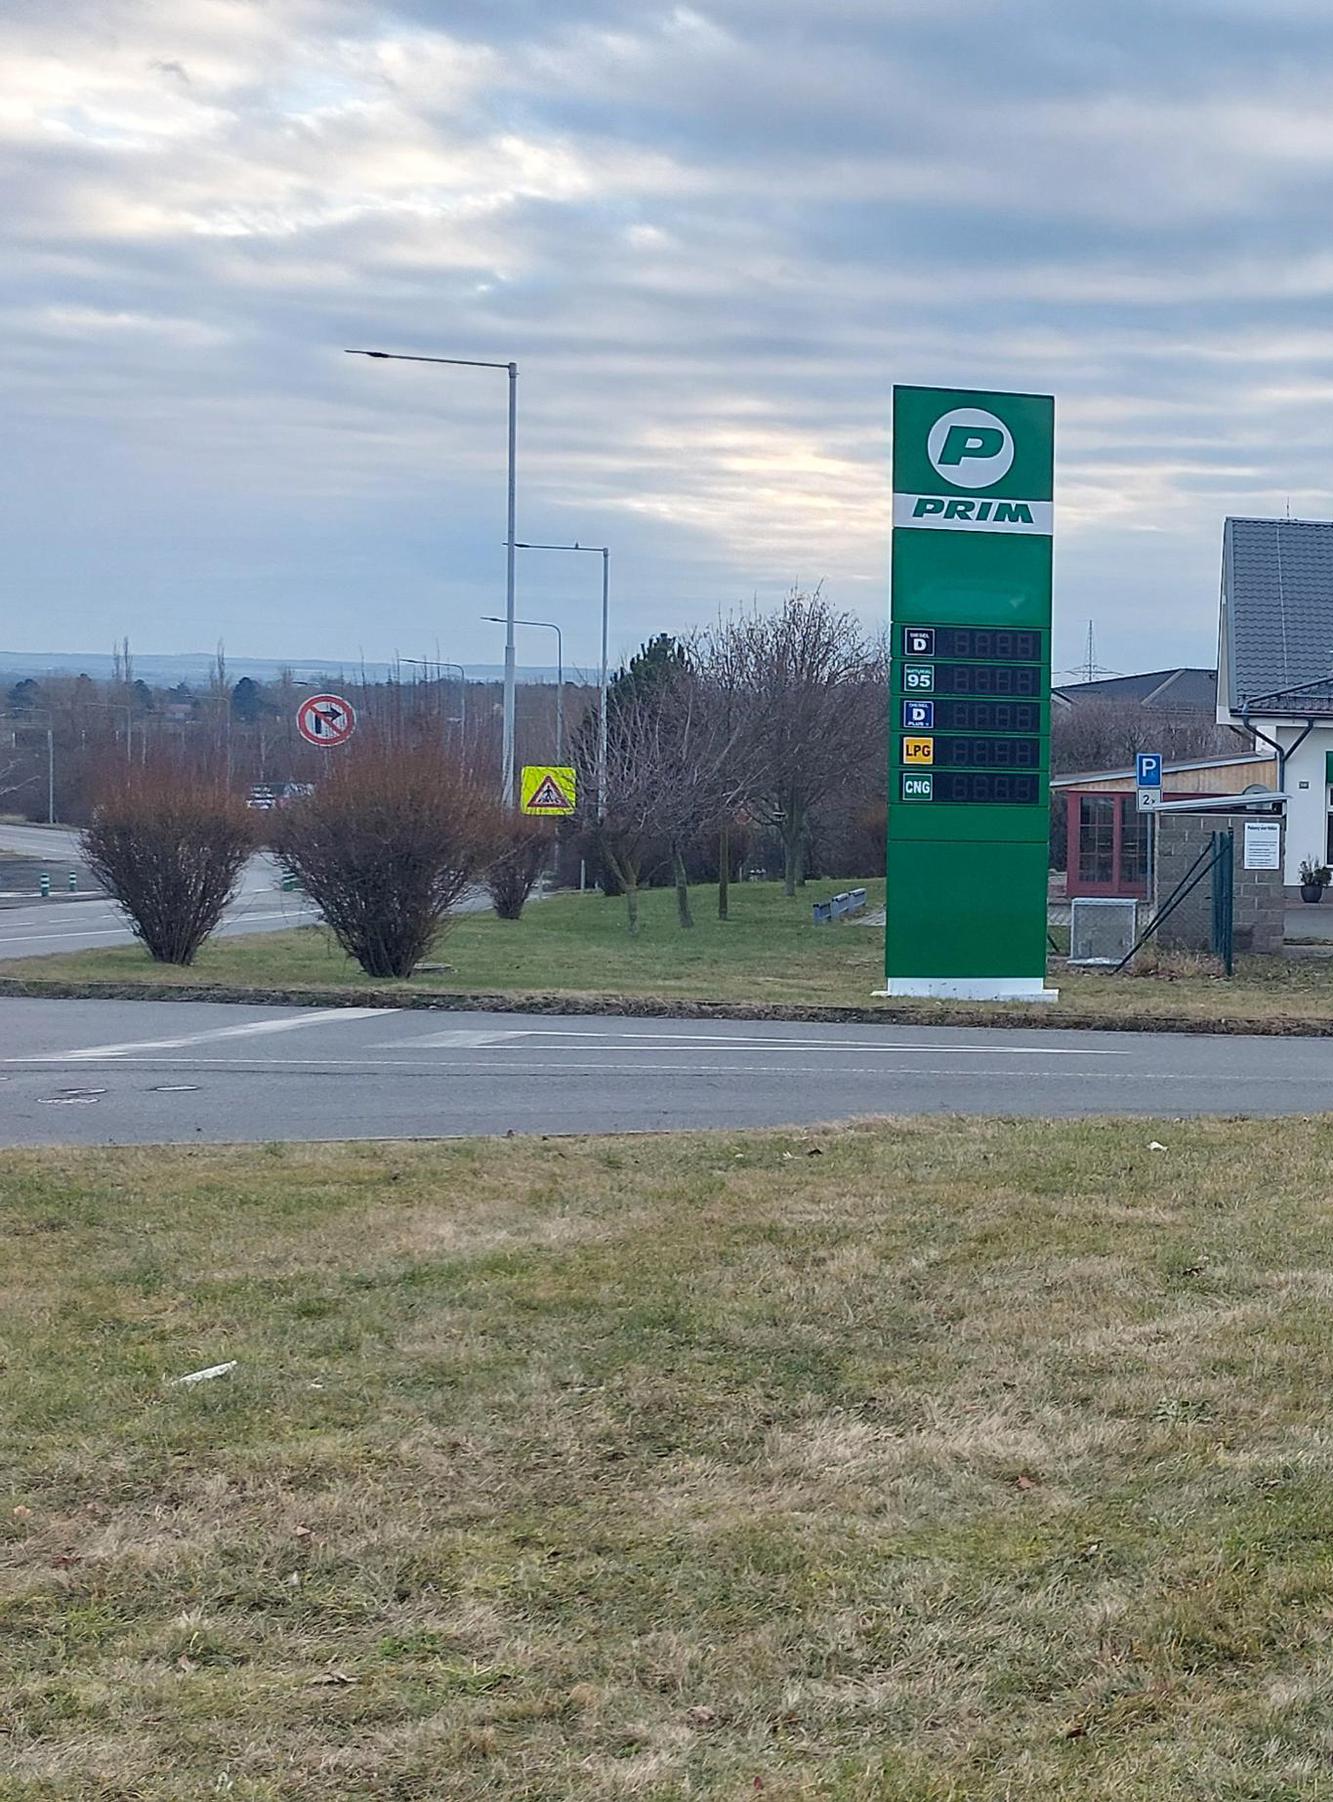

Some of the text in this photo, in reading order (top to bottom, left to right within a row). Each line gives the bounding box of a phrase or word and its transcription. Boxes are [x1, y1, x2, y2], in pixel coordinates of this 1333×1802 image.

[938, 425, 1005, 466] P
[912, 498, 1034, 523] PRIM
[913, 638, 927, 651] D
[907, 674, 931, 687] 95
[912, 708, 926, 721] D
[905, 744, 931, 757] LPG
[1142, 758, 1157, 777] P
[905, 780, 931, 794] CNG
